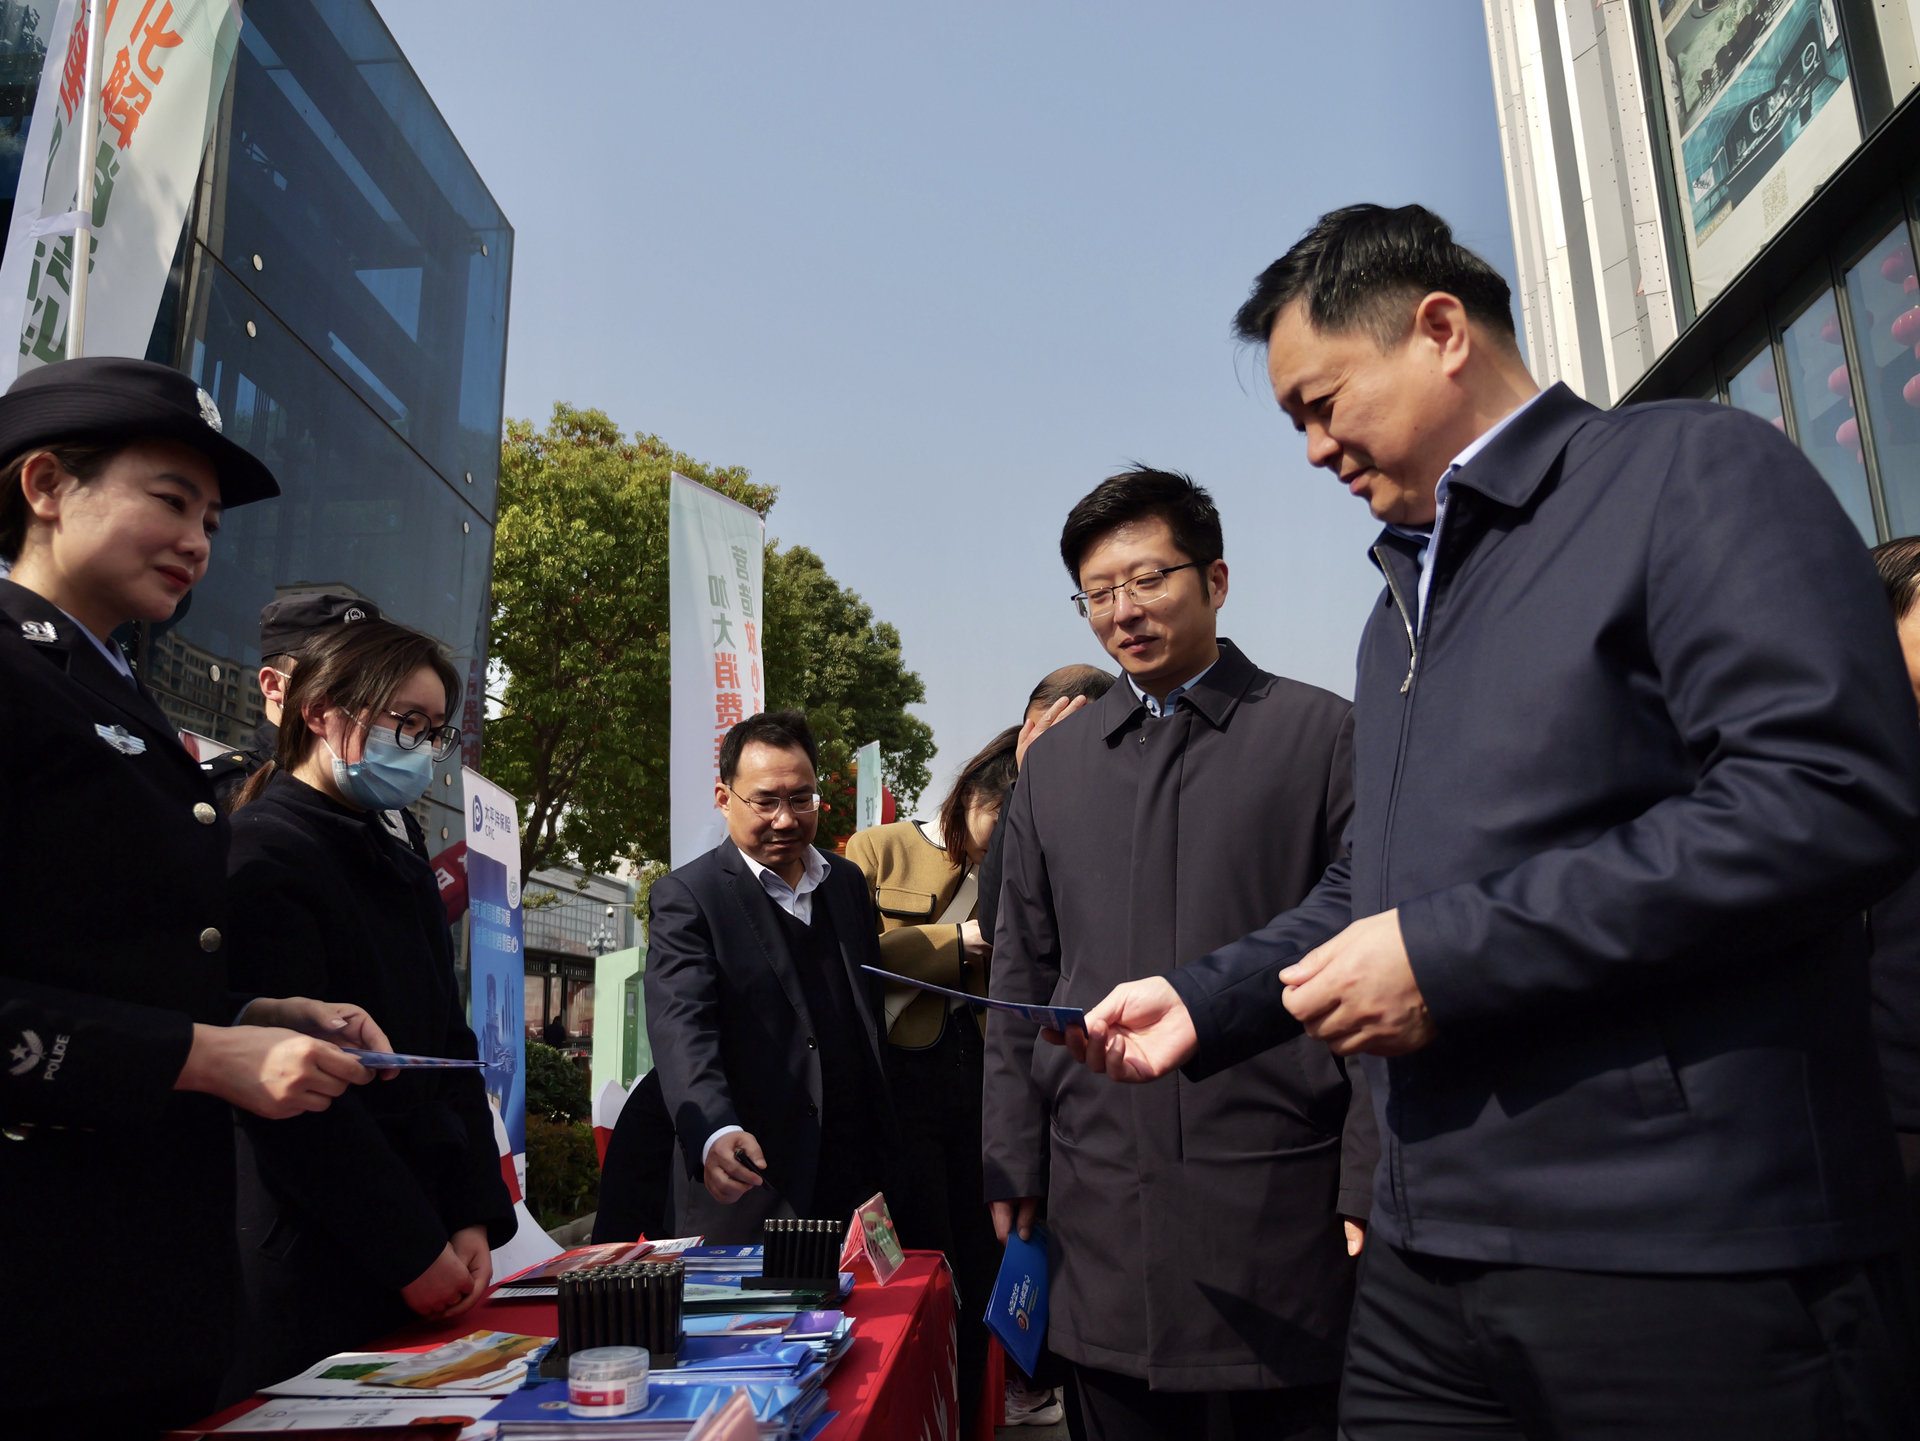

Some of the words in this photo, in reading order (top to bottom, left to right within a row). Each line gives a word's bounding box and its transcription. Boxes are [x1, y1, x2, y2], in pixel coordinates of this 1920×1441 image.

[484, 803, 512, 834] 太平洋保险
[43, 1033, 71, 1081] POLICE
